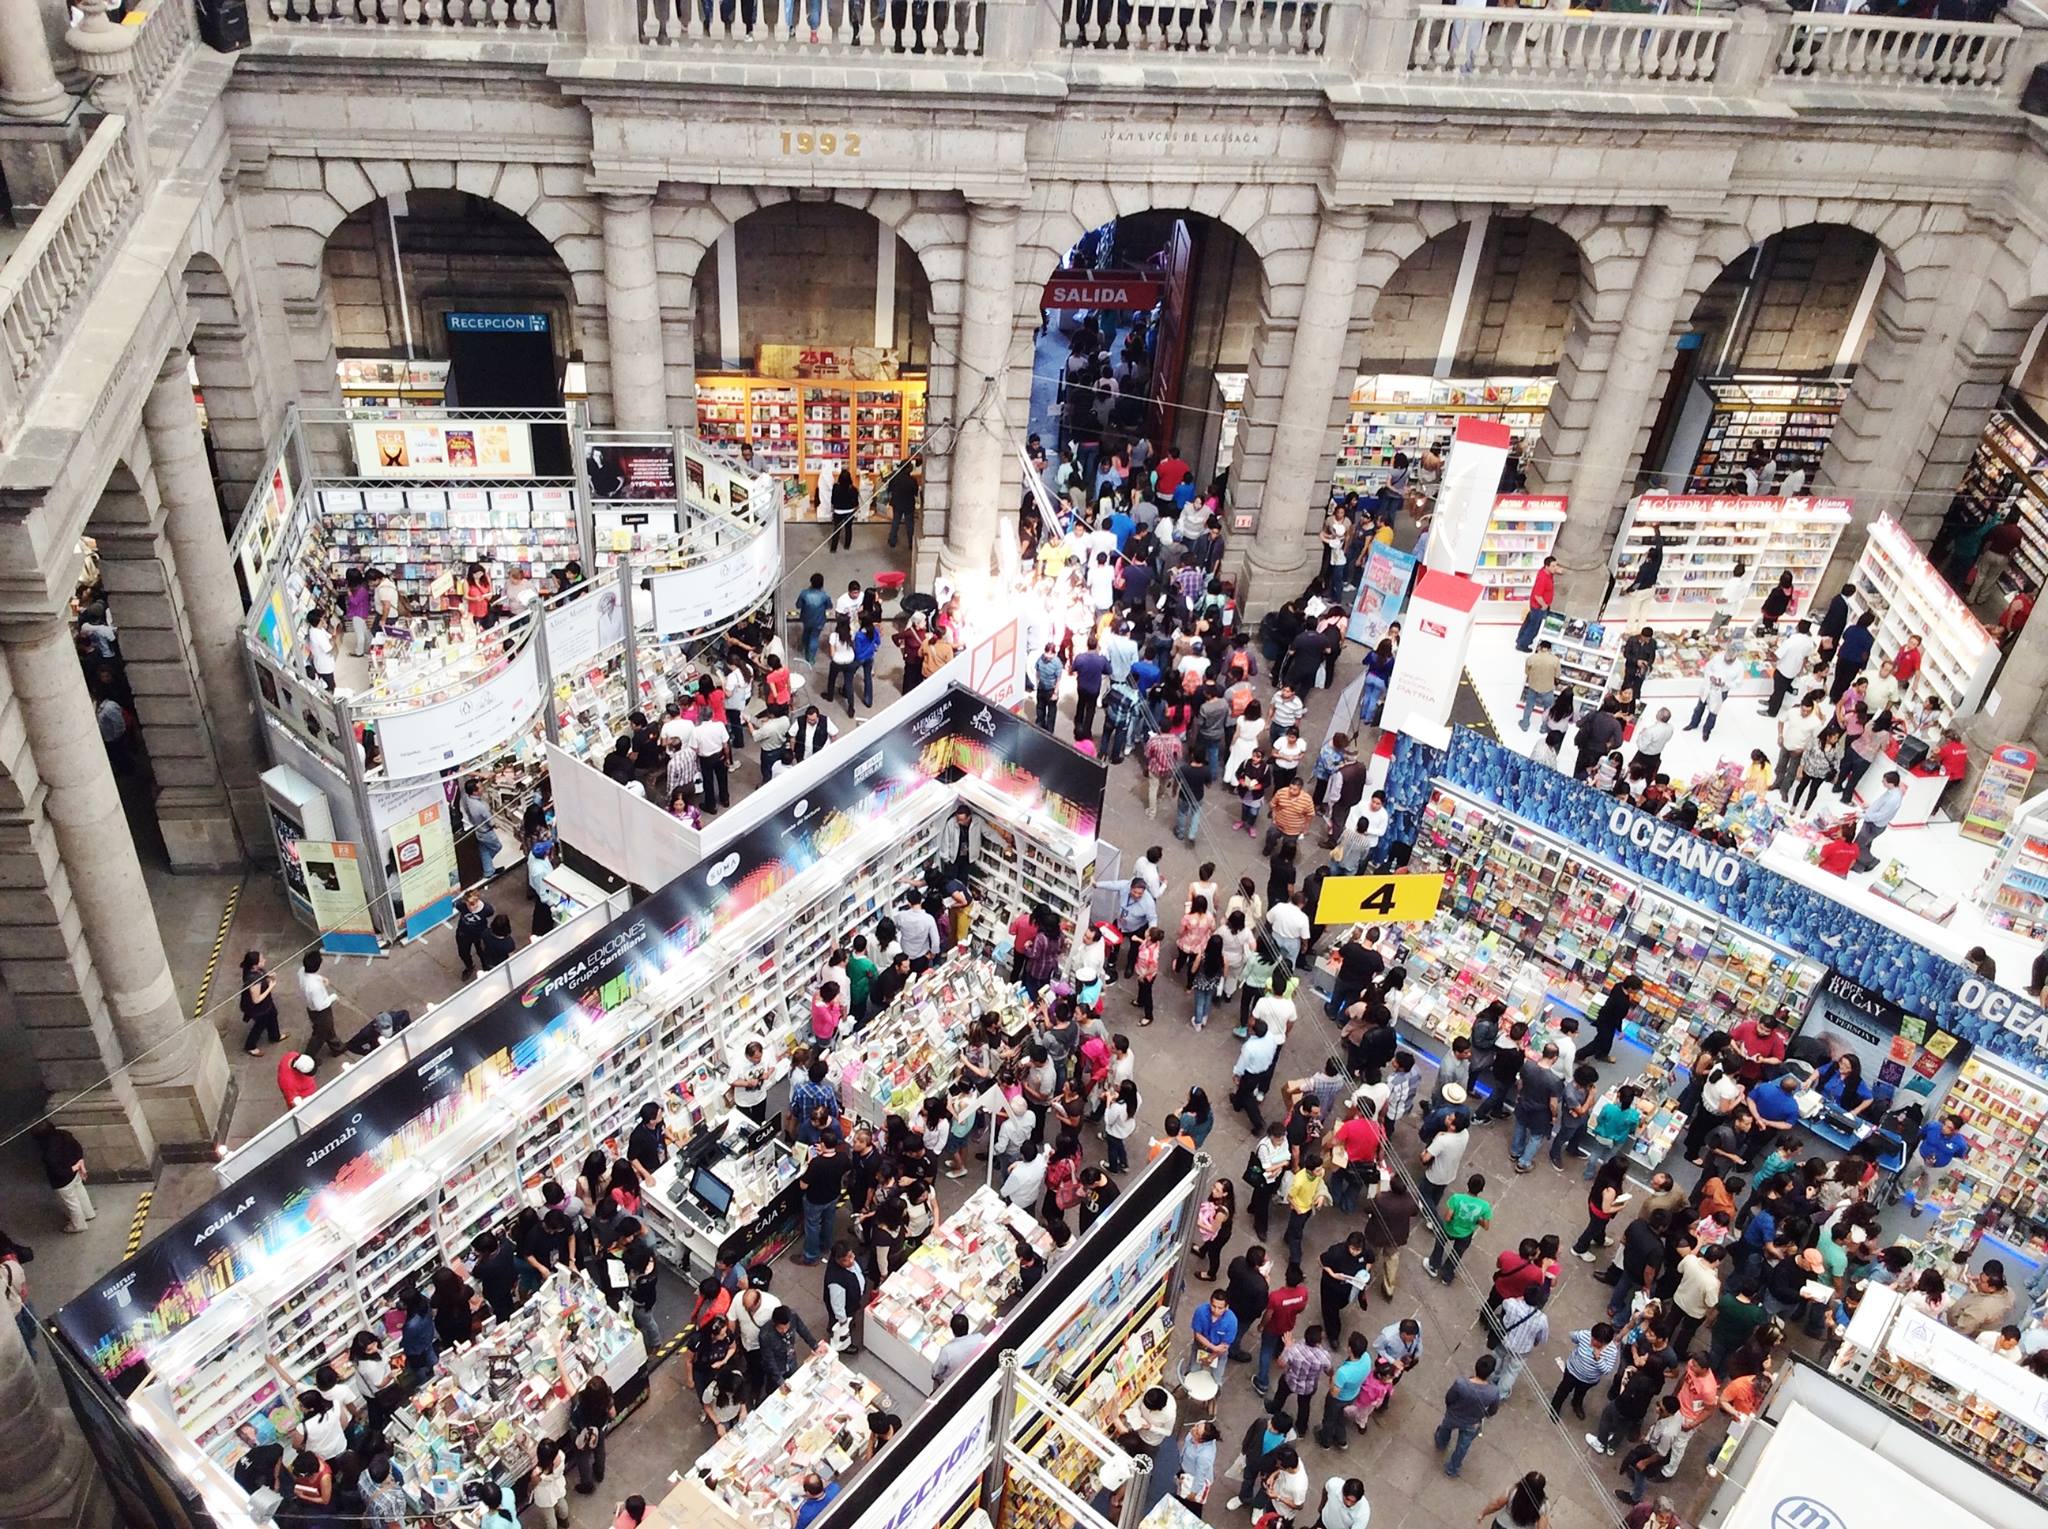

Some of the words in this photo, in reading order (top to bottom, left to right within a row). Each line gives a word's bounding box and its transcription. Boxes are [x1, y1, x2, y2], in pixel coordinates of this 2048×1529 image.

[780, 132, 860, 156] 1992
[1053, 288, 1128, 303] SALIDA
[451, 317, 525, 328] RECEPCIÓN
[800, 351, 818, 365] 25
[1653, 497, 1707, 511] CÁTEDRA
[1723, 498, 1778, 511] CÁTEDRA
[1396, 684, 1436, 703] PATRIA
[911, 700, 952, 734] ALFAGUARA
[1609, 806, 1740, 887] OCEANO
[1360, 883, 1396, 914] 4
[544, 961, 588, 997] PRISA
[588, 919, 646, 967] EDICIONES
[568, 965, 600, 990] Grupo
[600, 931, 647, 969] Santillana
[1831, 975, 1864, 993] JORGE
[1827, 981, 1887, 1017] BUCAY
[1835, 1017, 1876, 1043] PERSONA
[306, 1126, 358, 1167] alamah
[194, 1195, 257, 1247] AGUILAR
[755, 1209, 778, 1234] CAJA
[102, 1271, 137, 1298] taurus
